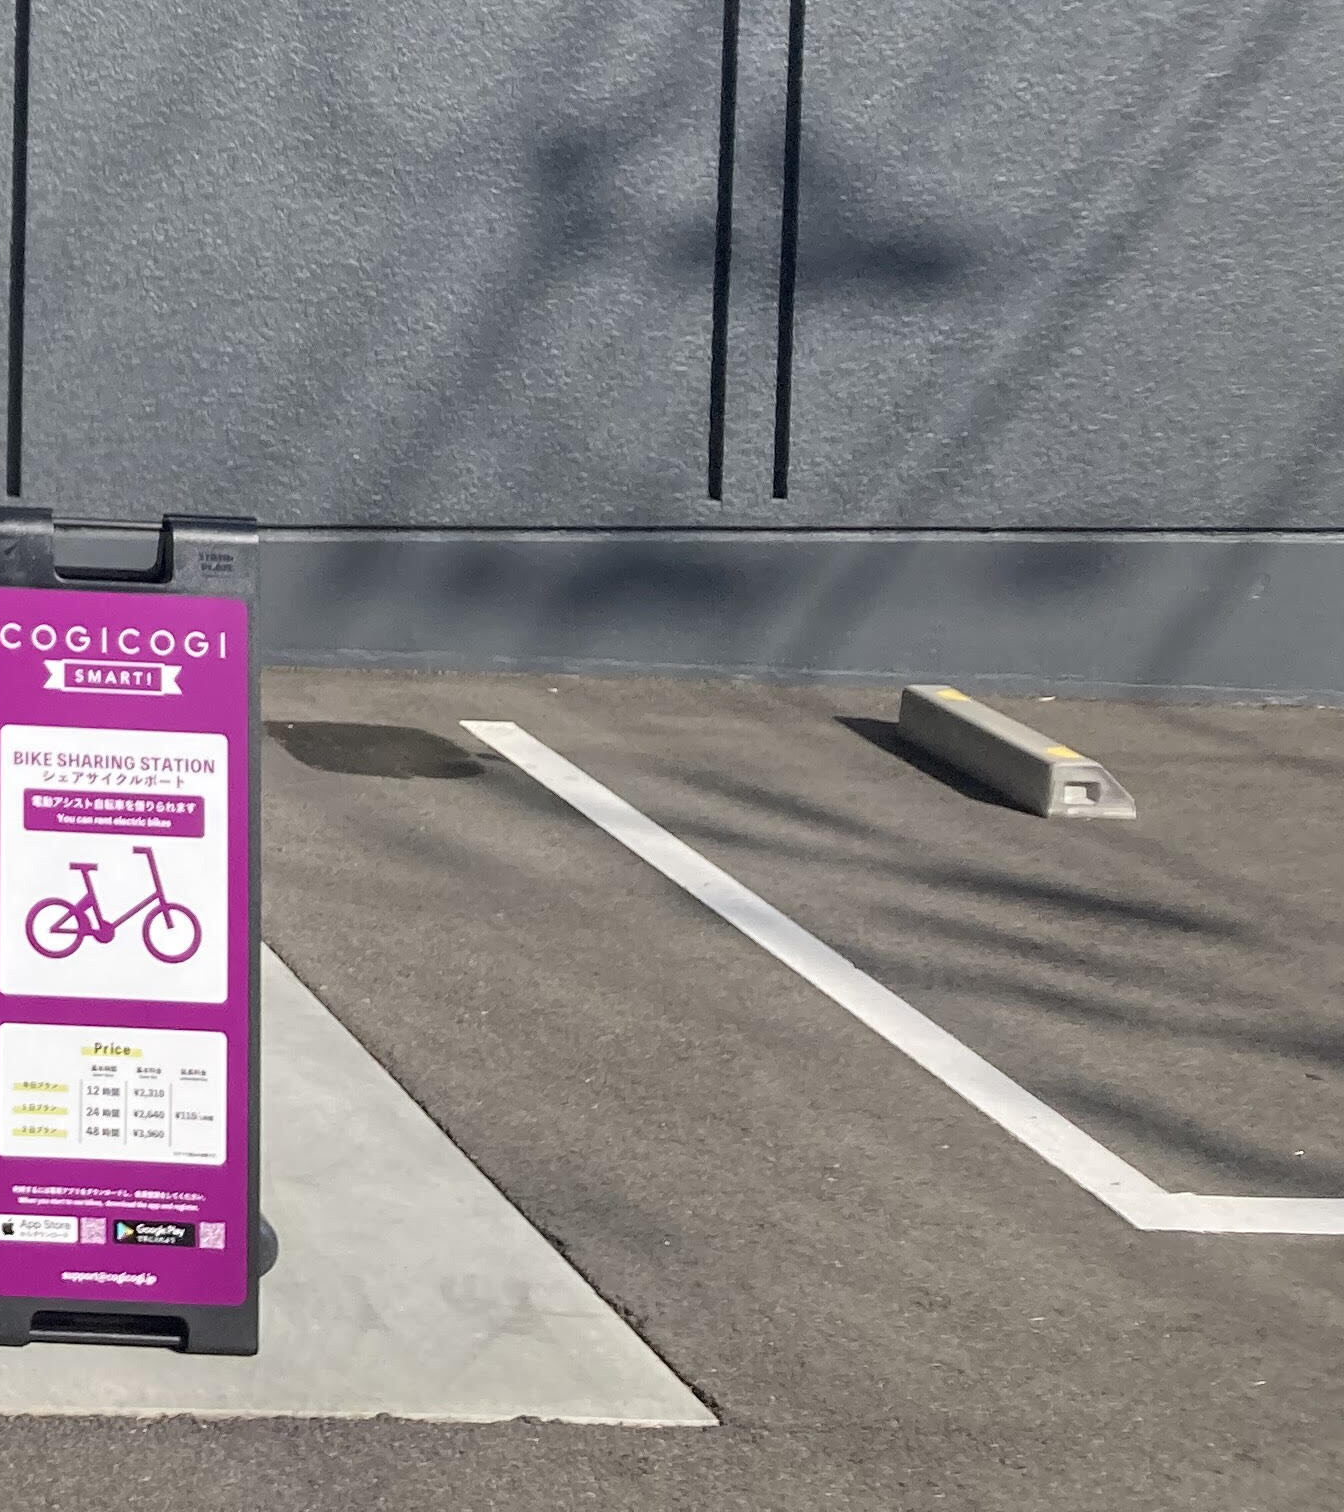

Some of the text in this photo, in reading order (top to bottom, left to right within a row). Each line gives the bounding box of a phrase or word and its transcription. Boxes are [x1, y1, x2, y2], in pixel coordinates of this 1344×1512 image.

[0, 622, 226, 659] COGICOGI
[74, 668, 153, 687] SMART!
[13, 750, 215, 774] BIKE SHARING STATION
[43, 770, 185, 789] シェアサイクルポート
[56, 812, 76, 824] You
[76, 815, 94, 825] can
[93, 1041, 131, 1056] Price
[86, 1085, 100, 1096] 12
[86, 1106, 100, 1117] 24
[85, 1126, 100, 1136] 48
[20, 1219, 72, 1230] App Store
[136, 1223, 166, 1237] Google
